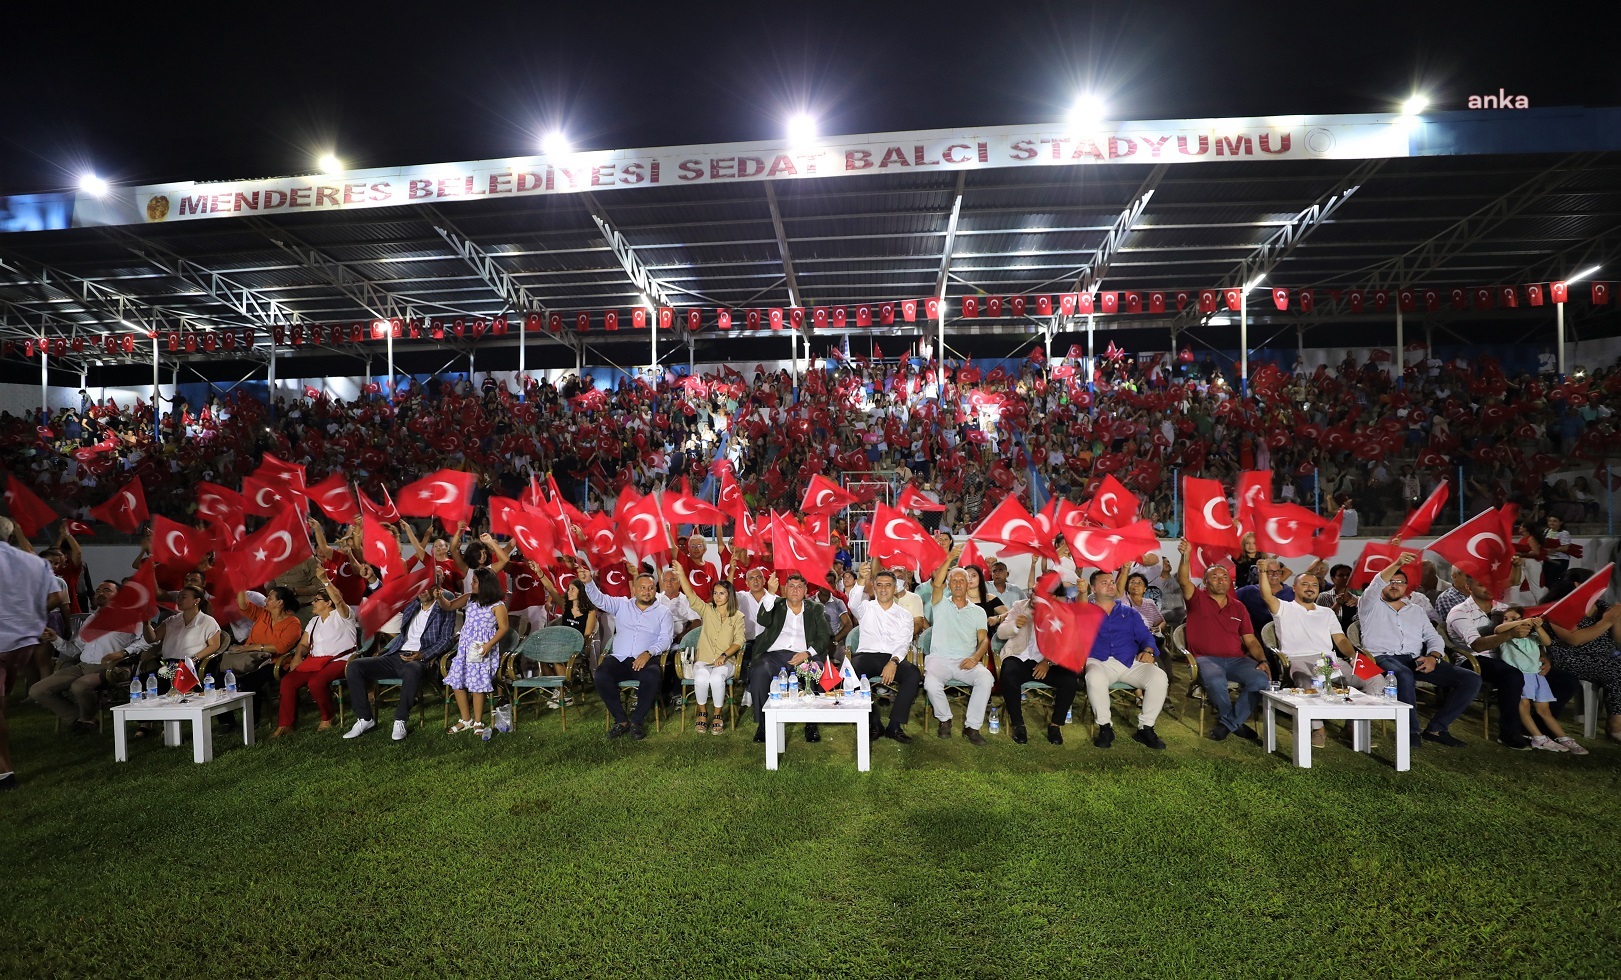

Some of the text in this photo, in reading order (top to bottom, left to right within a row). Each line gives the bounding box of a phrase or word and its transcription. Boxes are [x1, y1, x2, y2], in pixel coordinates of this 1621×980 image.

[179, 182, 392, 216] MENDERES
[408, 158, 660, 200] BELEDİYESİ
[1009, 131, 1292, 161] STADYUMU
